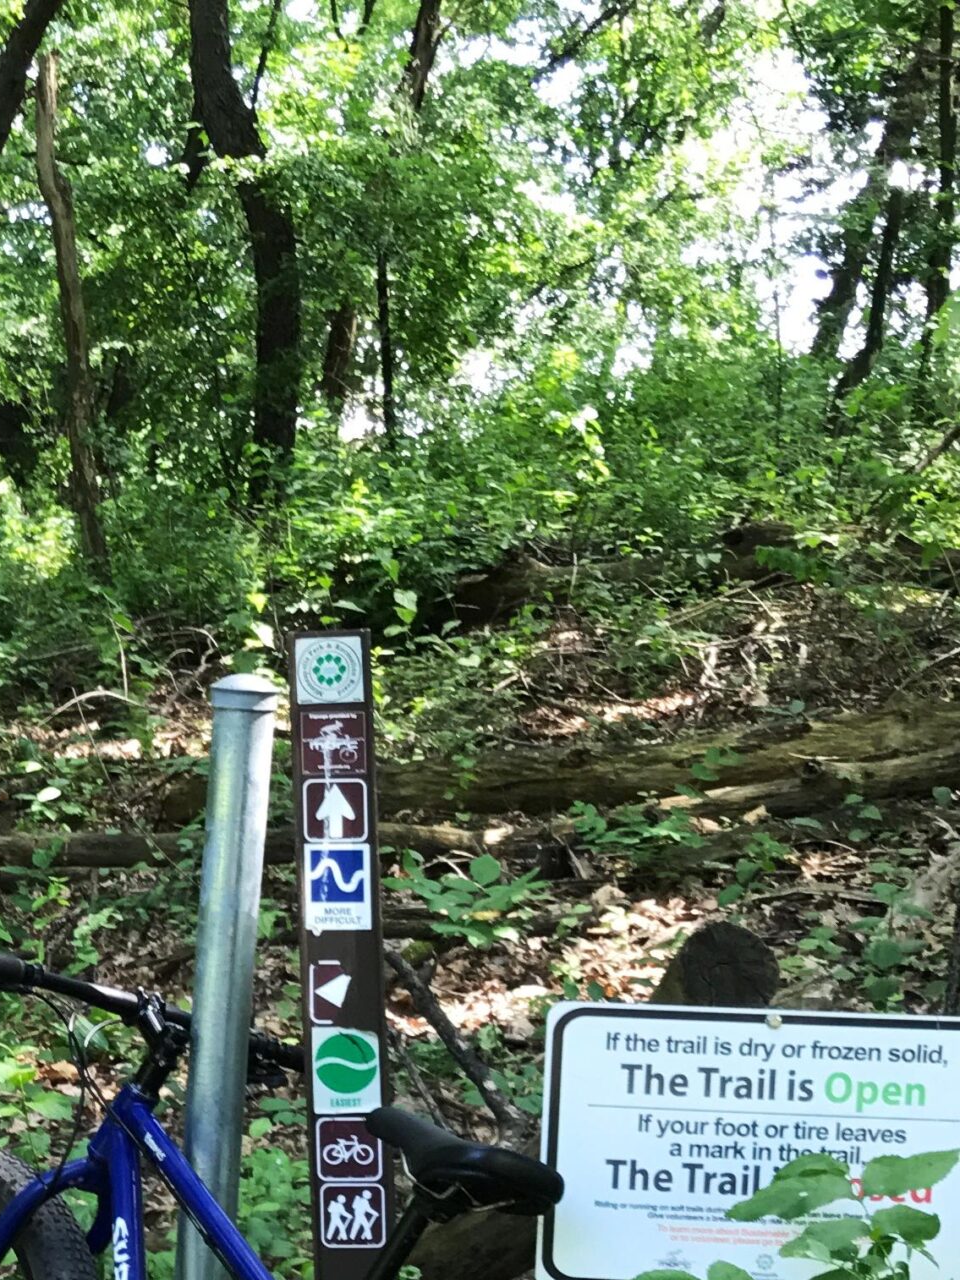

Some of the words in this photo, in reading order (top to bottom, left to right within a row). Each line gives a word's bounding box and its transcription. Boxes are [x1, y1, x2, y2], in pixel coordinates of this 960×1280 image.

[314, 916, 362, 924] DIFFICULT
[606, 1032, 620, 1050] If
[625, 1033, 659, 1052] the
[666, 1036, 707, 1054] trail
[714, 1037, 732, 1055] is
[739, 1038, 775, 1062] dry
[781, 1044, 805, 1058] or
[811, 1040, 881, 1062] frozen
[888, 1044, 947, 1067] solid,
[330, 1098, 361, 1107] EASIEST
[621, 1064, 688, 1097] The
[698, 1067, 776, 1100] Trail
[787, 1070, 813, 1102] is
[825, 1072, 926, 1113] Open
[638, 1114, 652, 1132] If
[656, 1119, 709, 1138] your
[714, 1117, 758, 1137] foot
[765, 1124, 788, 1138] or
[794, 1121, 829, 1140] tire
[836, 1123, 907, 1143] leaves
[670, 1142, 682, 1156] a
[690, 1141, 745, 1160] mark
[752, 1142, 771, 1160] in
[606, 1159, 673, 1192] The
[682, 1163, 761, 1196] Trail
